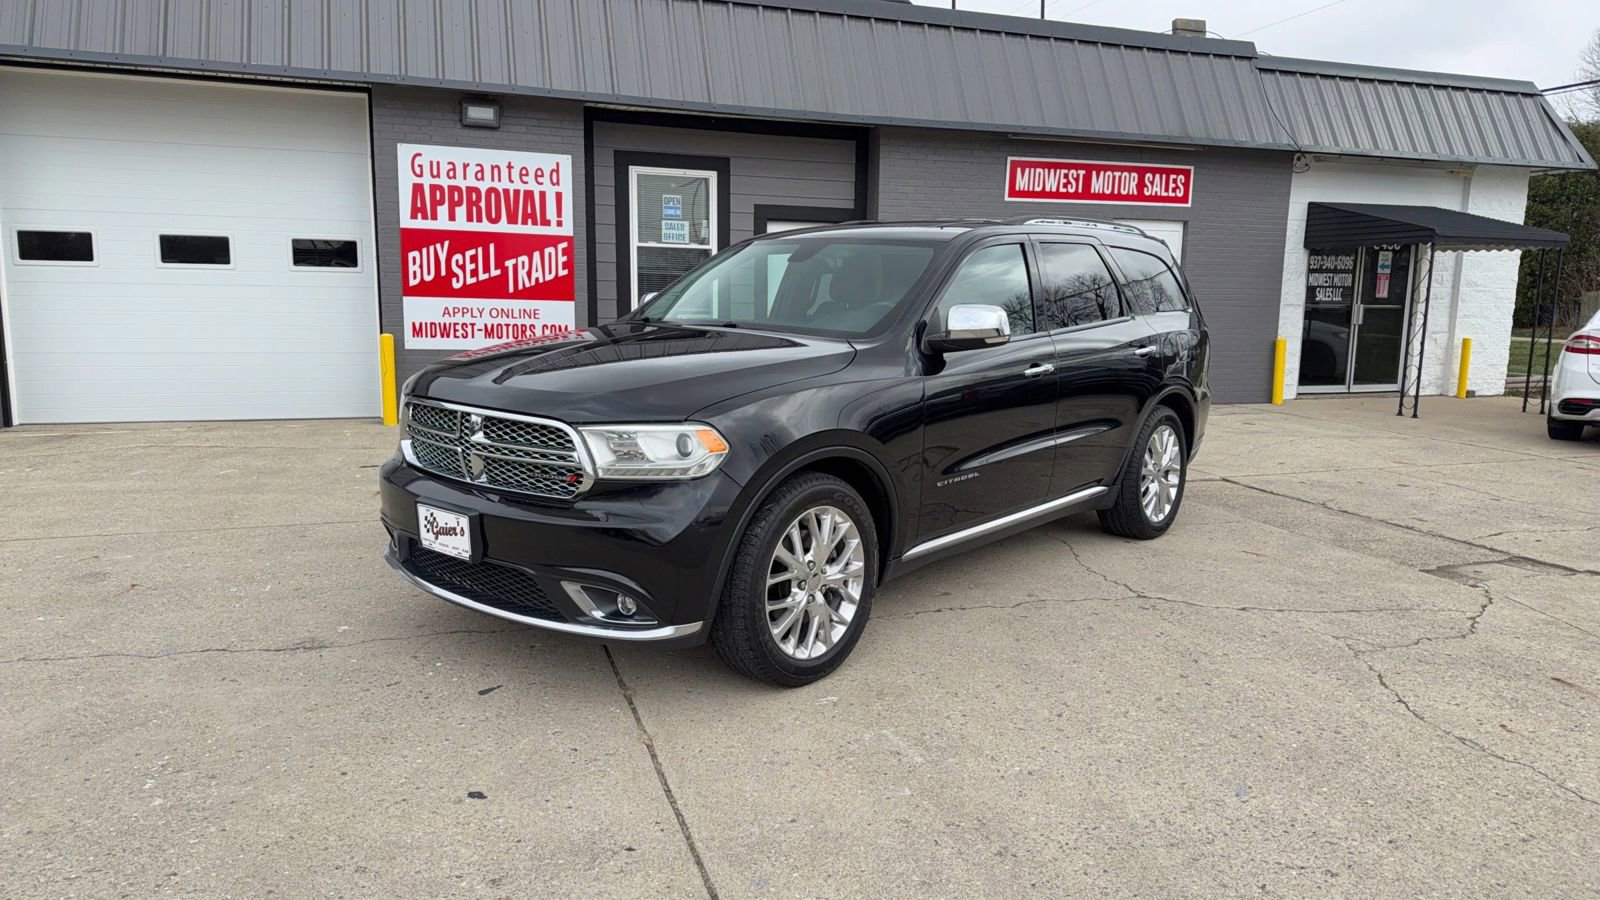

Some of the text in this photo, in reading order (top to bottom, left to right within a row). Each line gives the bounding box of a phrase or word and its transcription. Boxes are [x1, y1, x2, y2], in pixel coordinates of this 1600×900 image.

[410, 152, 560, 187] Guaranteed
[1015, 167, 1185, 198] MIDWEST MOTOR SALES
[409, 182, 564, 228] APPROVAL!
[663, 196, 681, 206] OPEN
[664, 222, 685, 232] SALES
[663, 232, 687, 242] OFFICE
[407, 240, 569, 294] BUY SELL TRADE
[1309, 255, 1355, 270] 937-340-6096
[1308, 272, 1353, 287] MIDWEST MOTOR
[1315, 287, 1343, 301] SALES LLC
[442, 306, 540, 320] APPLY ONLINE
[411, 321, 569, 341] MIDWEST-MOTORSCO
[936, 471, 980, 487] CITADEL
[431, 518, 465, 541] Gaier's
